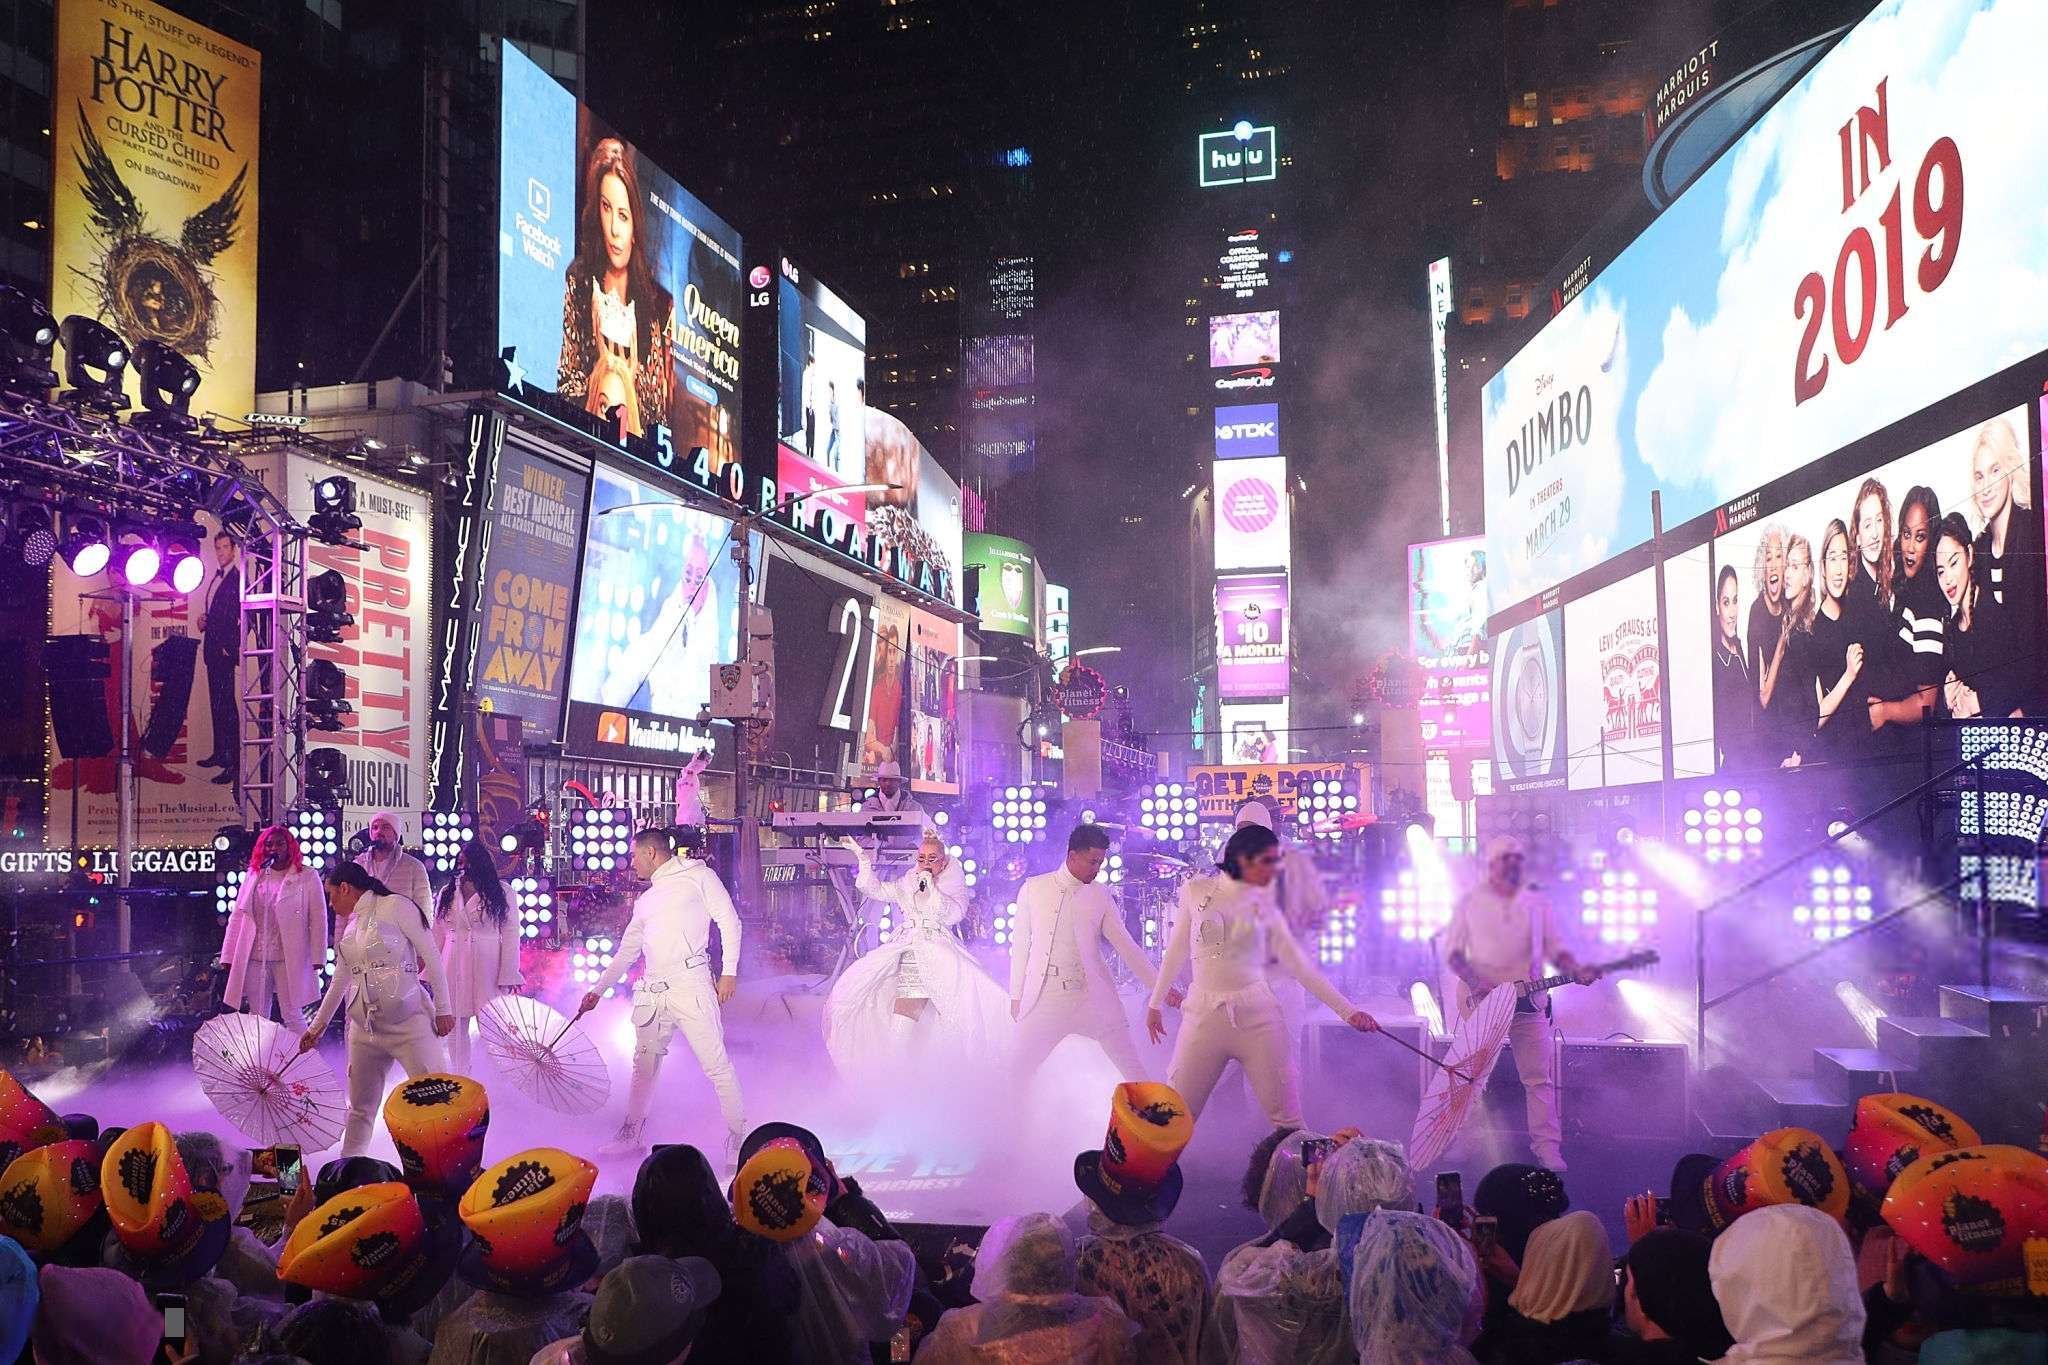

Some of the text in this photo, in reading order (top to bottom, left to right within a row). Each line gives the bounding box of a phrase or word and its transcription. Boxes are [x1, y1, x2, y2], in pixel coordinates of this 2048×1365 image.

[120, 2, 145, 20] THE
[148, 14, 184, 38] STUFF
[187, 32, 203, 48] OF
[100, 18, 228, 109] HARRY
[1657, 40, 1718, 107] MARRIOTT
[91, 55, 236, 153] POTTER
[1658, 70, 1709, 128] MARQUIS
[106, 116, 220, 170] CURSED CHILD
[144, 120, 185, 142] AND THE
[1838, 75, 1891, 214] IN
[122, 139, 205, 175] PARTS ONE AND TWO
[1212, 147, 1263, 168] hulu
[124, 158, 202, 193] ON BROADWAY
[515, 212, 562, 255] Facebook
[522, 236, 555, 271] Watch
[1220, 252, 1268, 264] COUNTDOWN
[788, 266, 799, 284] LG
[1563, 256, 1591, 290] MARRIOTT
[1794, 136, 1964, 407] 2019
[750, 292, 770, 307] LG
[1436, 282, 1446, 331] NEW
[1564, 274, 1588, 305] MARQUIS
[683, 284, 740, 348] Queen
[662, 306, 740, 381] America
[722, 379, 734, 392] Series
[248, 414, 301, 424] LAMAR
[1232, 422, 1275, 439] TDK
[1506, 385, 1592, 499] DUMBO
[360, 491, 366, 508] A
[523, 464, 566, 502] WINNER!
[1537, 478, 1563, 506] THEATERS
[503, 484, 575, 533] BEST MUSICAL
[1729, 492, 1760, 514] MARRIOTT
[1729, 506, 1757, 527] MARQUIS
[501, 514, 511, 528] ALL
[512, 517, 534, 535] ACROSS
[535, 521, 551, 541] NORTH
[552, 526, 575, 548] AMERICA
[761, 476, 950, 600] BROADWAY
[1526, 496, 1571, 560] MARCH 29
[494, 569, 570, 621] COME
[151, 626, 161, 639] THE
[362, 528, 411, 760] PRETTY
[489, 605, 563, 657] FROM
[1599, 632, 1614, 652] LEVI
[1615, 619, 1644, 645] STRAUSS
[830, 598, 881, 733] 21
[1234, 643, 1284, 657] MONTH
[483, 647, 561, 692] AWAY
[1060, 688, 1093, 699] planet
[1064, 696, 1101, 706] fitness
[629, 717, 678, 751] YouTube
[343, 760, 410, 808] MUSICAL
[1195, 771, 1247, 796] GET
[1199, 799, 1233, 811] WITH
[0, 851, 72, 873] GIFTS
[757, 1182, 788, 1216] planet
[863, 1177, 968, 1193] EACREST
[1948, 1218, 1989, 1236] planet
[1957, 1227, 2003, 1242] fitness
